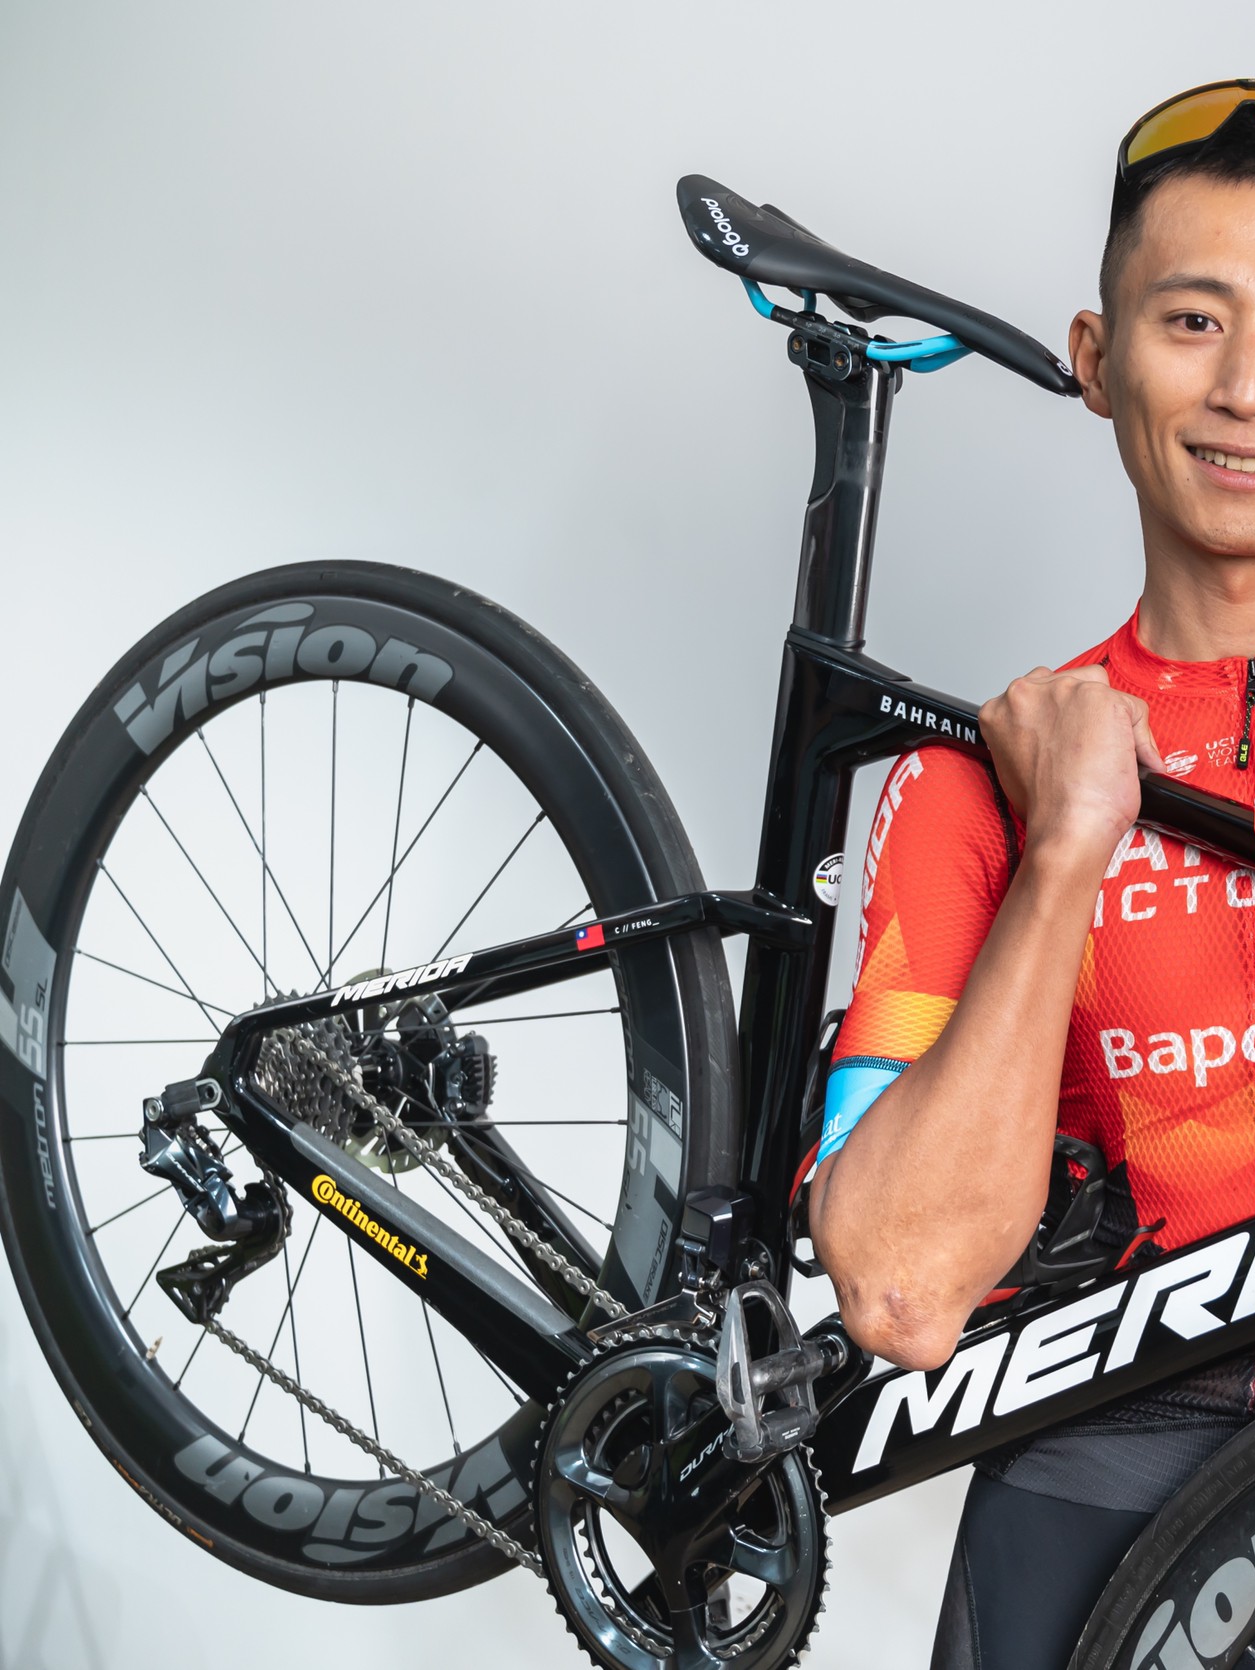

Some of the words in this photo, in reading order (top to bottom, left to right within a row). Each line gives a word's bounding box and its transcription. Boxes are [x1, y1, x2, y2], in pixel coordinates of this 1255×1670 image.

[700, 197, 750, 257] prologo
[113, 602, 454, 757] Vision
[880, 695, 977, 744] BAHRAIN
[330, 952, 475, 1007] MERIDA
[311, 1174, 417, 1267] Continental
[173, 1435, 529, 1563] Vision
